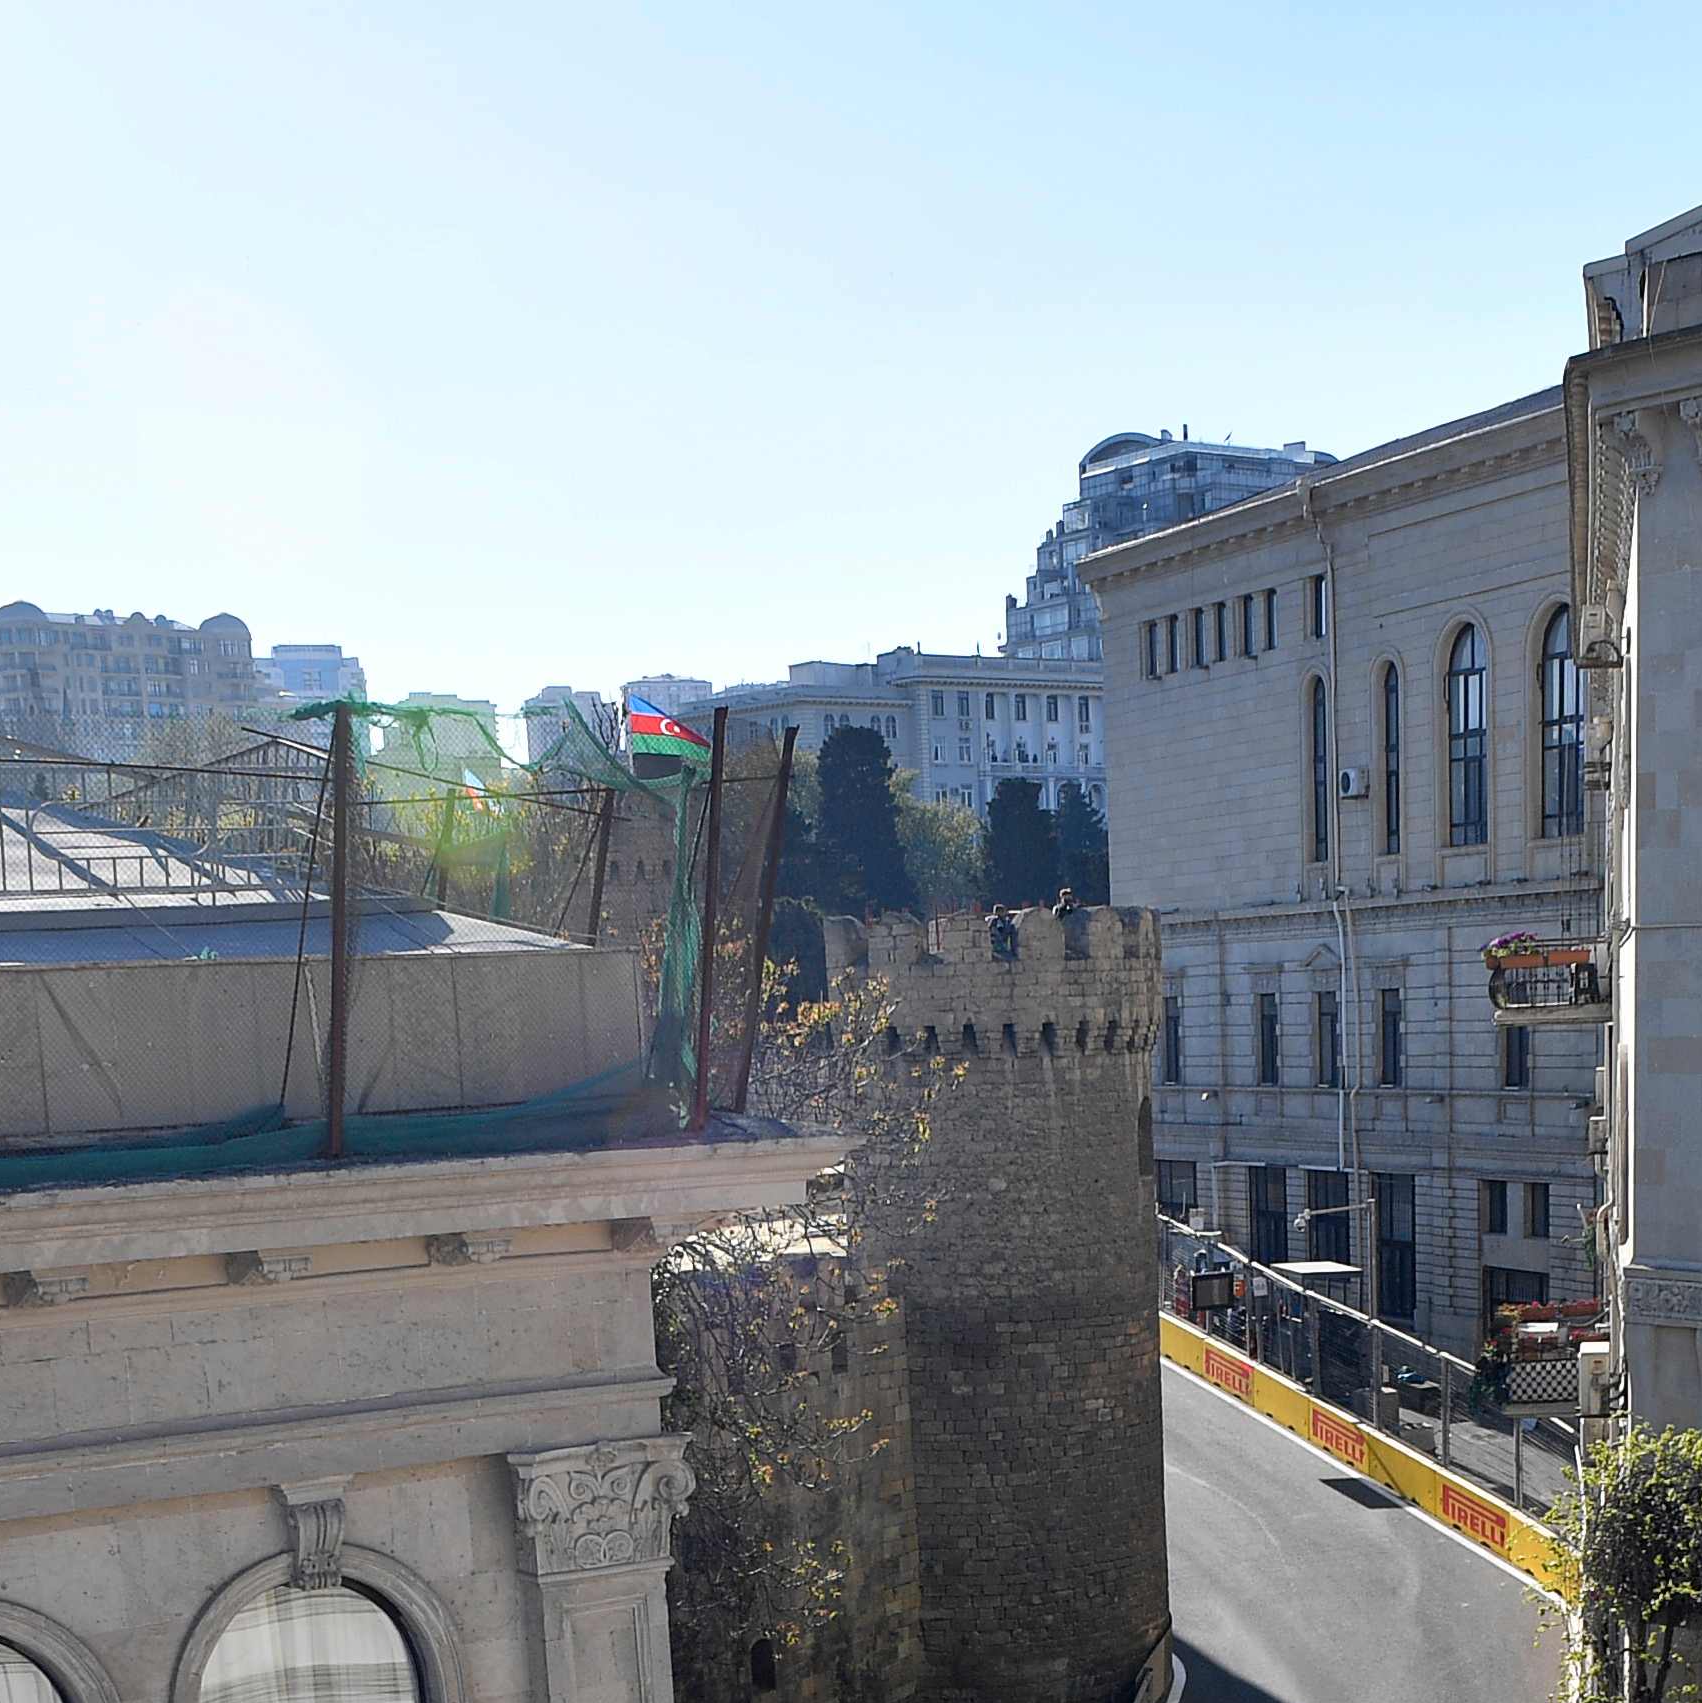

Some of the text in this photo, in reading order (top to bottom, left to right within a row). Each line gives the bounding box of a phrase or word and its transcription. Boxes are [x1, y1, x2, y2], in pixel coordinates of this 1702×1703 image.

[1205, 1349, 1254, 1396] PIRELLI
[1313, 1408, 1365, 1464] PIRELLI
[1442, 1483, 1506, 1548] PIRELLI
